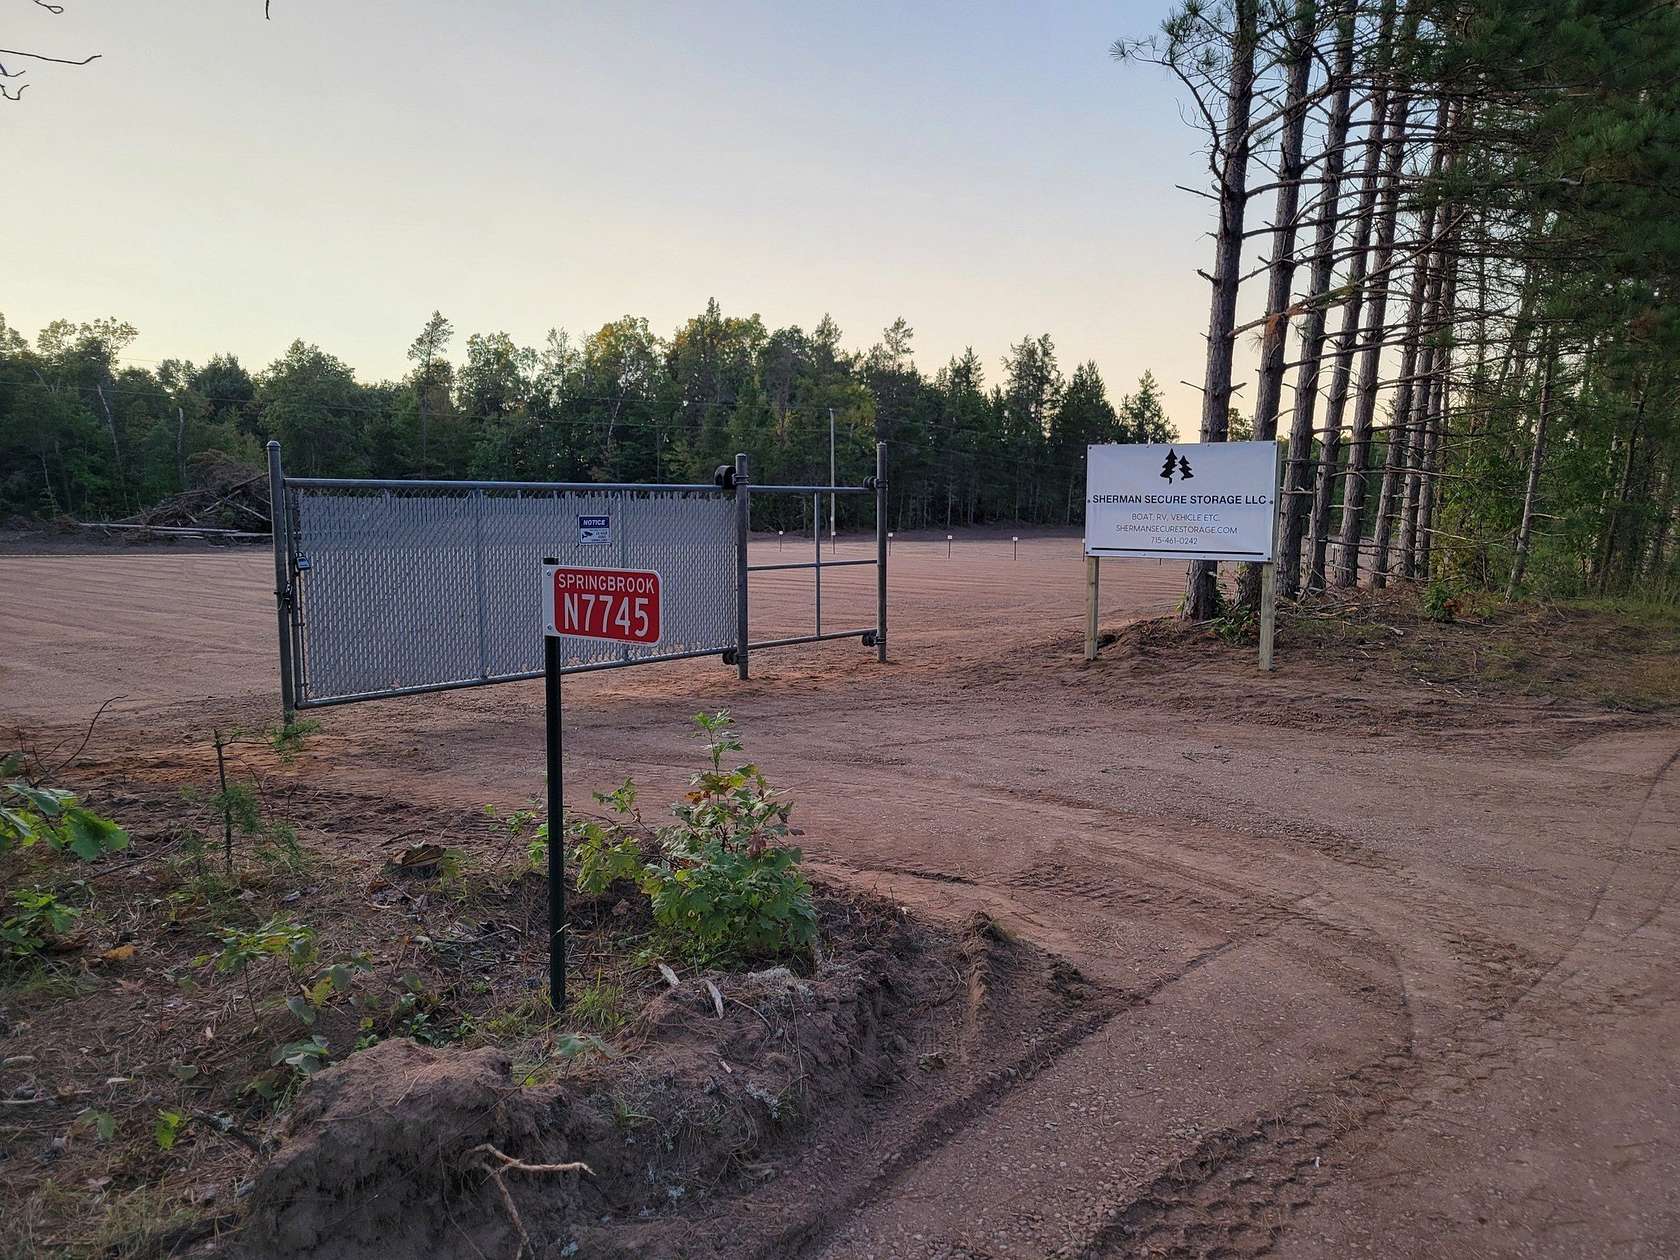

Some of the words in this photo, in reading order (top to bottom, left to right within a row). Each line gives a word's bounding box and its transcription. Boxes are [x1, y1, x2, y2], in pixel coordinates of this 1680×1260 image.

[1092, 494, 1142, 504] SHERMAN
[1144, 494, 1187, 504] SECURE
[1190, 495, 1242, 505] STORAGE
[1245, 495, 1267, 505] LLC
[1171, 513, 1202, 522] VEHICLE
[1151, 536, 1198, 545] 715-461-0242
[558, 573, 655, 594] SPRINGBROOK
[564, 592, 649, 637] N7745
